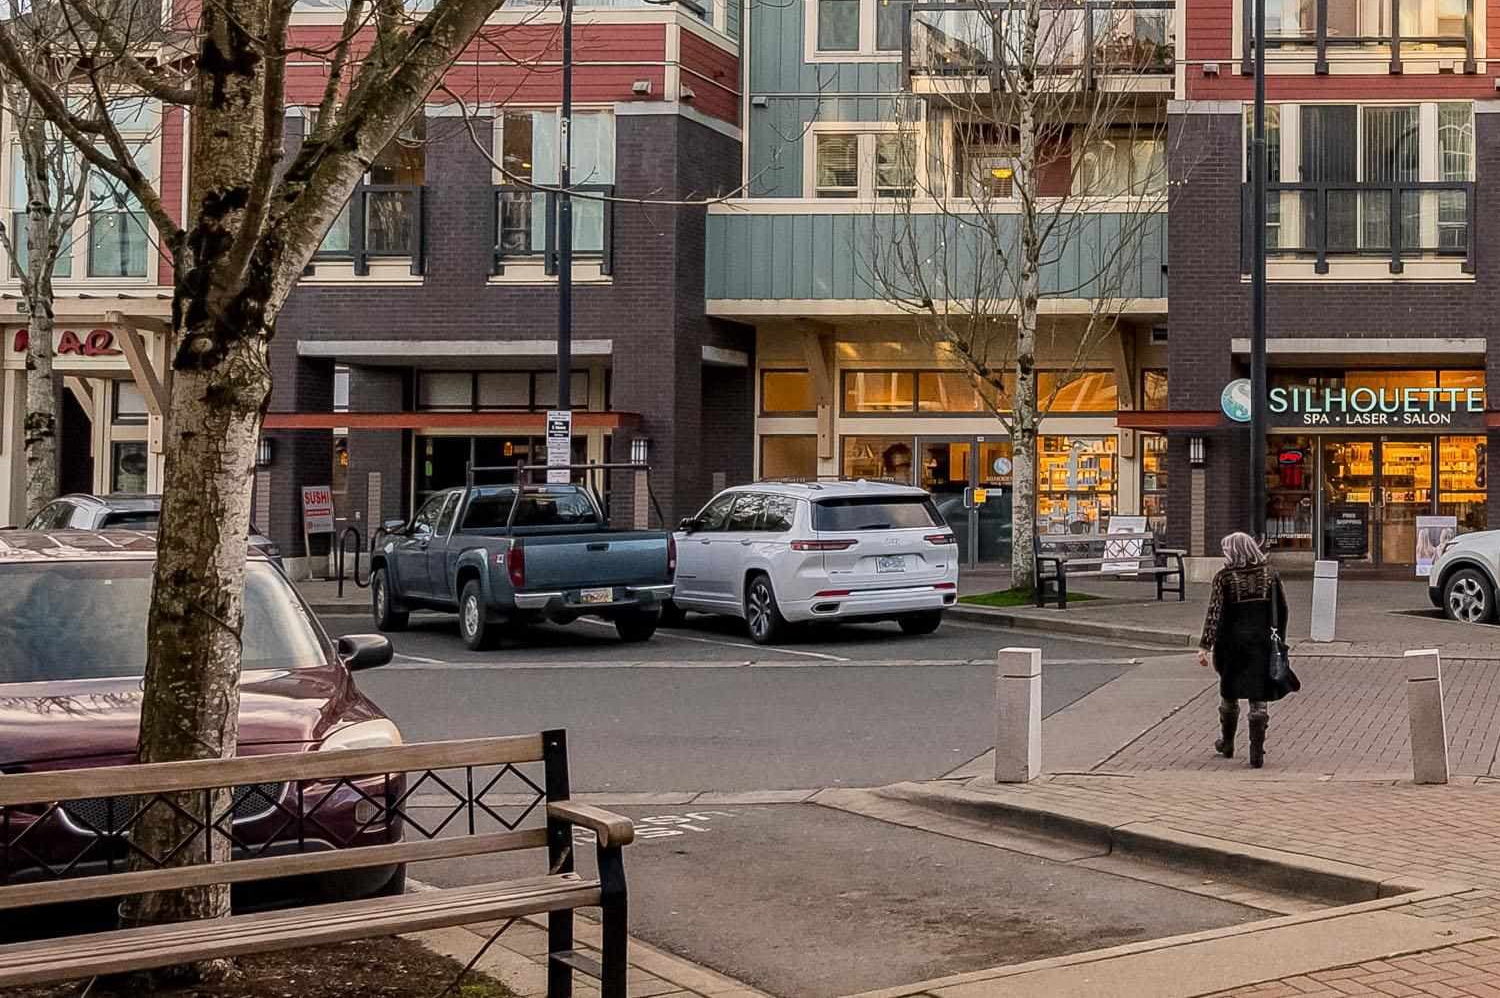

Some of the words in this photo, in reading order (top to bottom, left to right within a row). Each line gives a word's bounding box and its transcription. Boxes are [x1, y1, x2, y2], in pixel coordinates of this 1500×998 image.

[1268, 387, 1485, 413] SILHOUETTE
[1303, 413, 1330, 425] SPA
[1346, 413, 1388, 425] LASER
[1403, 413, 1451, 425] SALON
[304, 491, 330, 504] SUSHI
